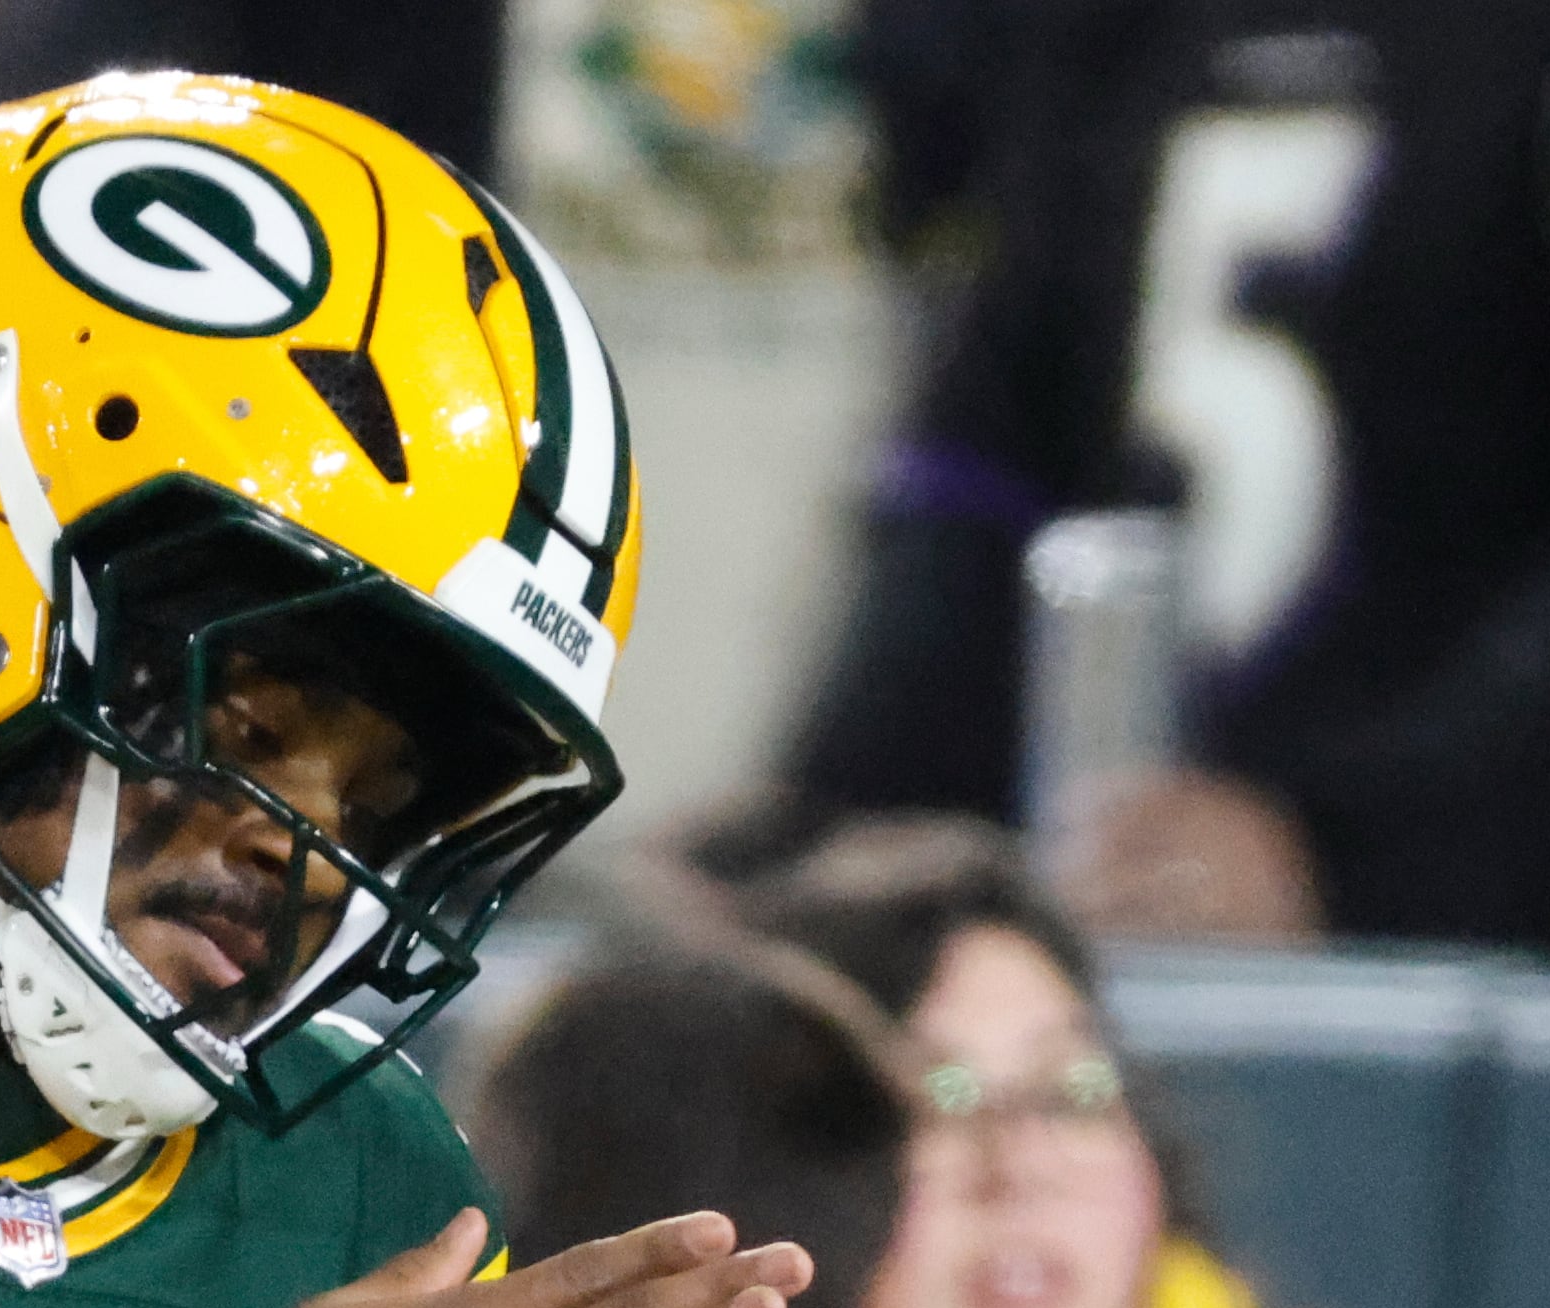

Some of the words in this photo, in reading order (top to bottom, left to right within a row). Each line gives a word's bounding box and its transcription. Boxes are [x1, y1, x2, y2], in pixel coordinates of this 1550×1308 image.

[37, 137, 314, 327] G
[1138, 103, 1385, 655] 5
[509, 578, 594, 669] PACKERS
[0, 1217, 55, 1260] NFL
